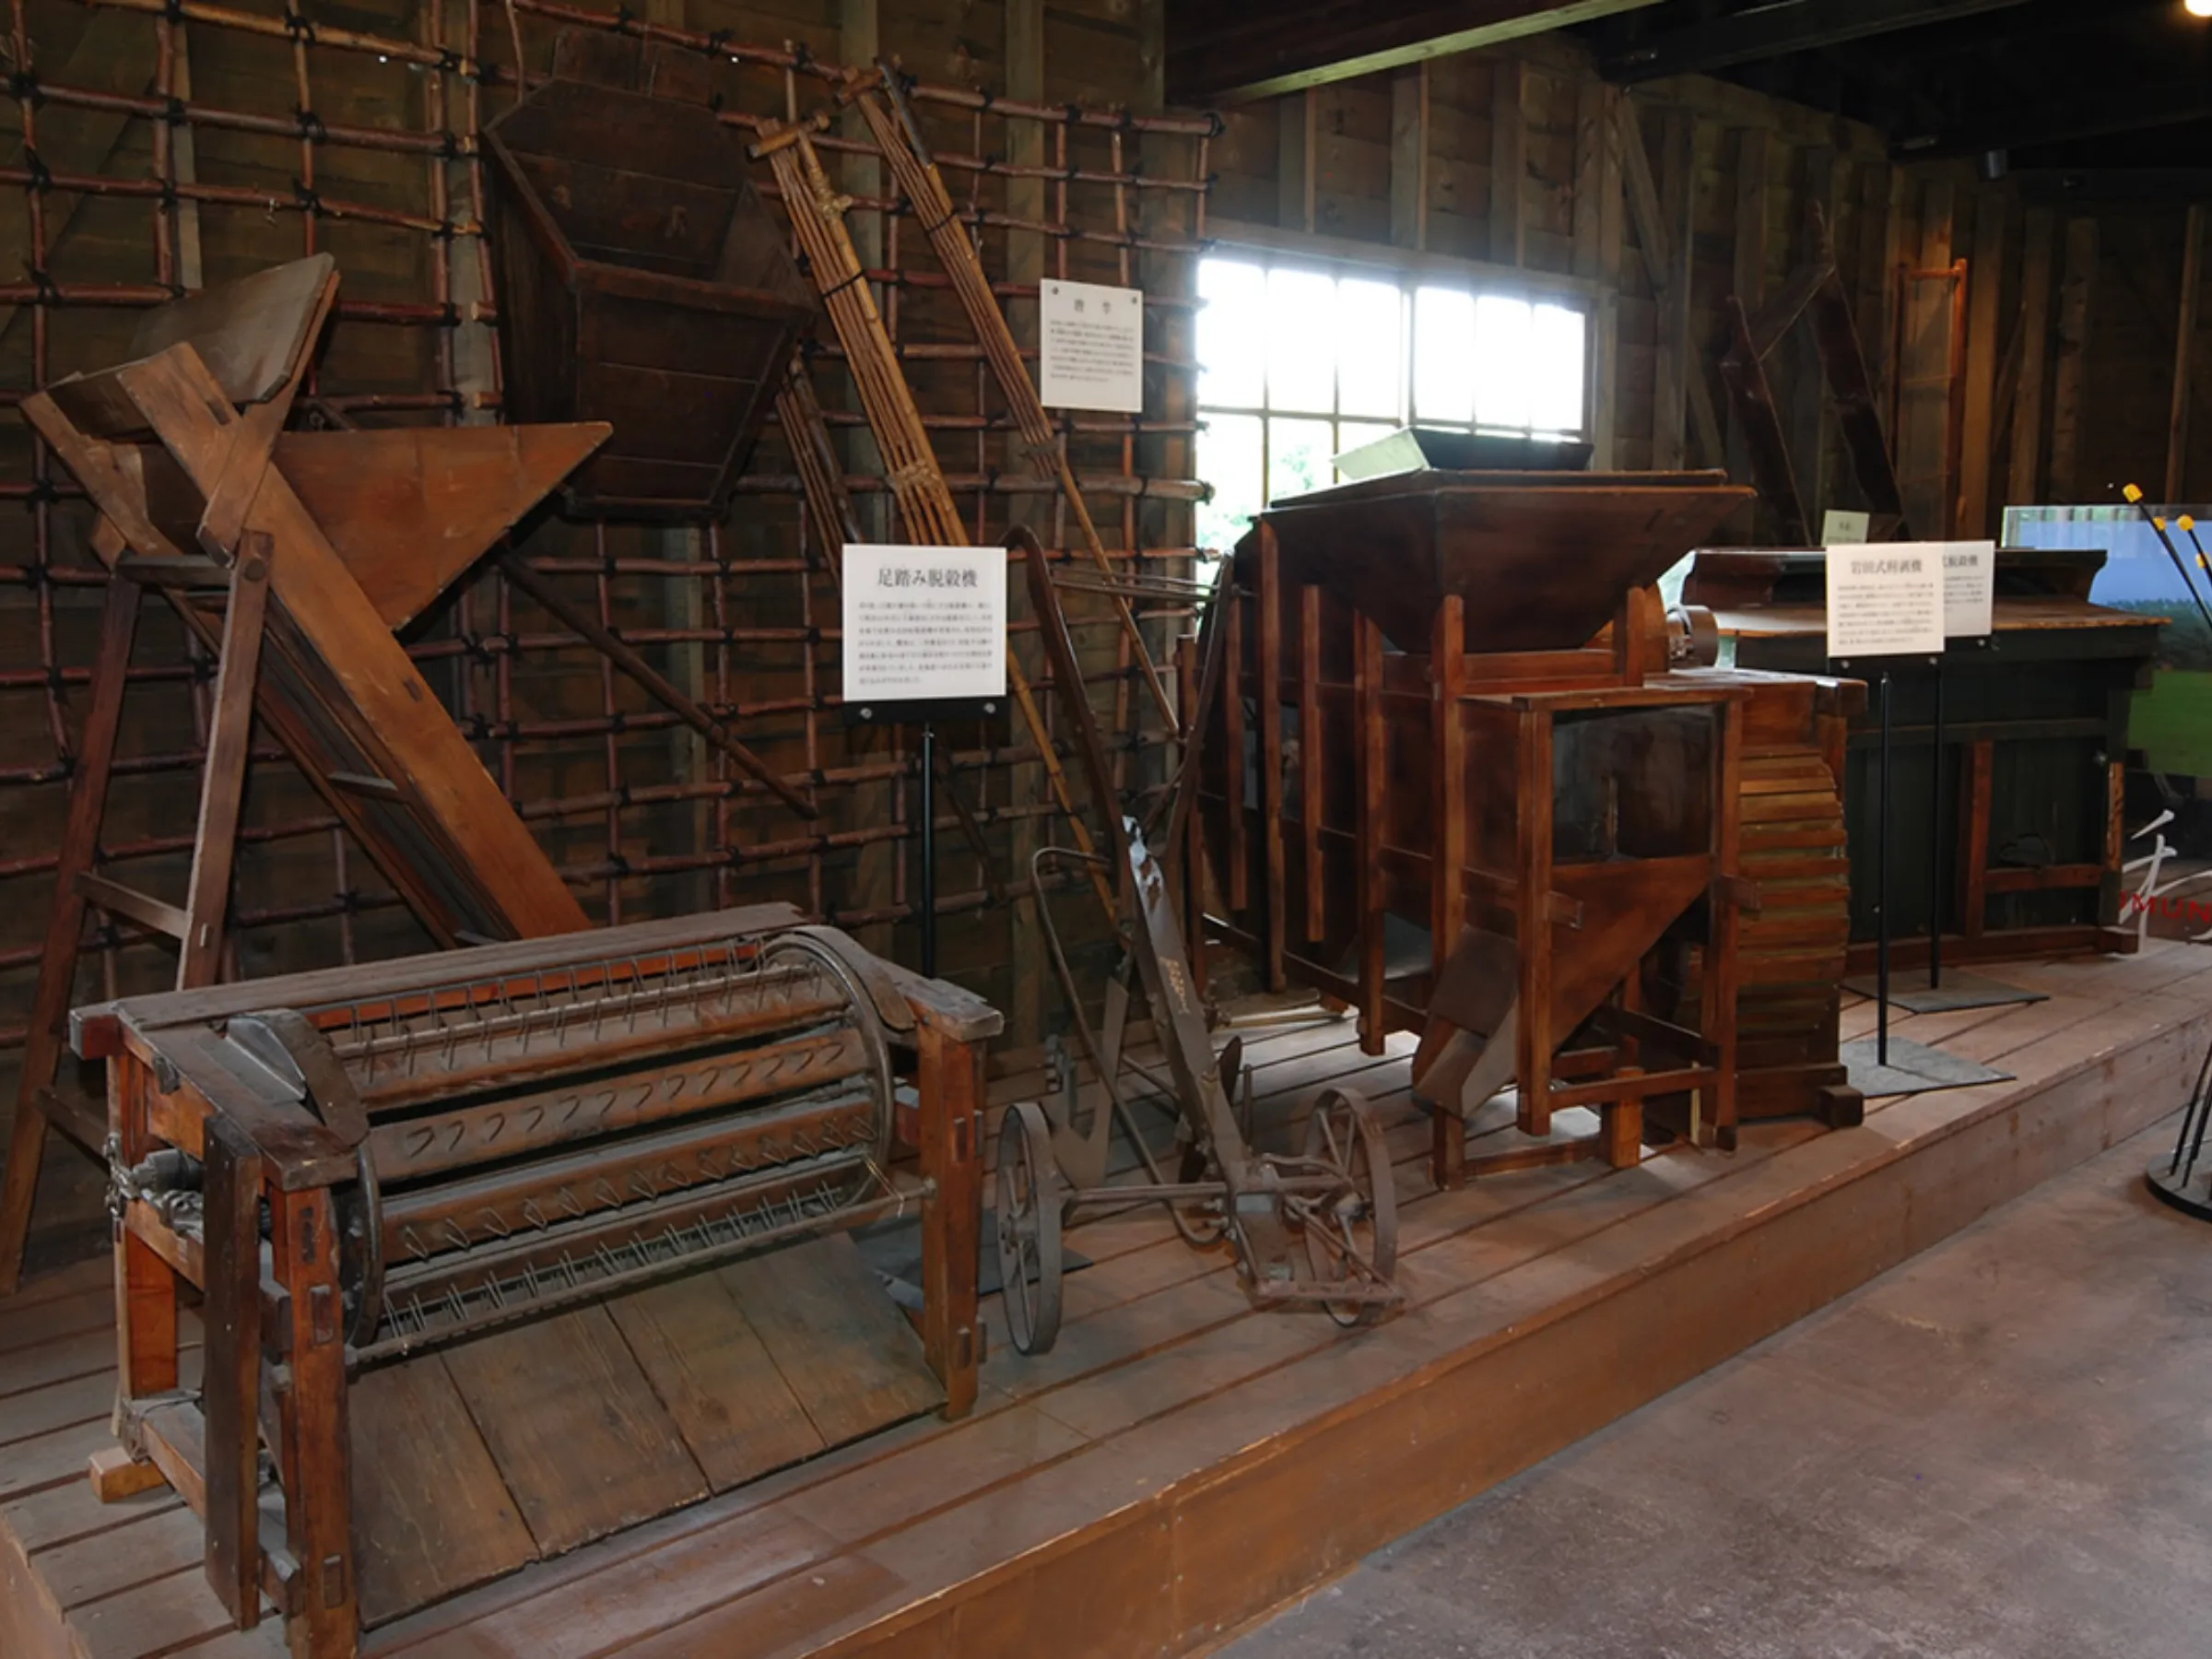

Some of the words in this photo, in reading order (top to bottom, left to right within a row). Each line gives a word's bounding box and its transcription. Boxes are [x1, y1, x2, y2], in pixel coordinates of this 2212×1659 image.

[877, 567, 978, 588] 足踏み脱穀機
